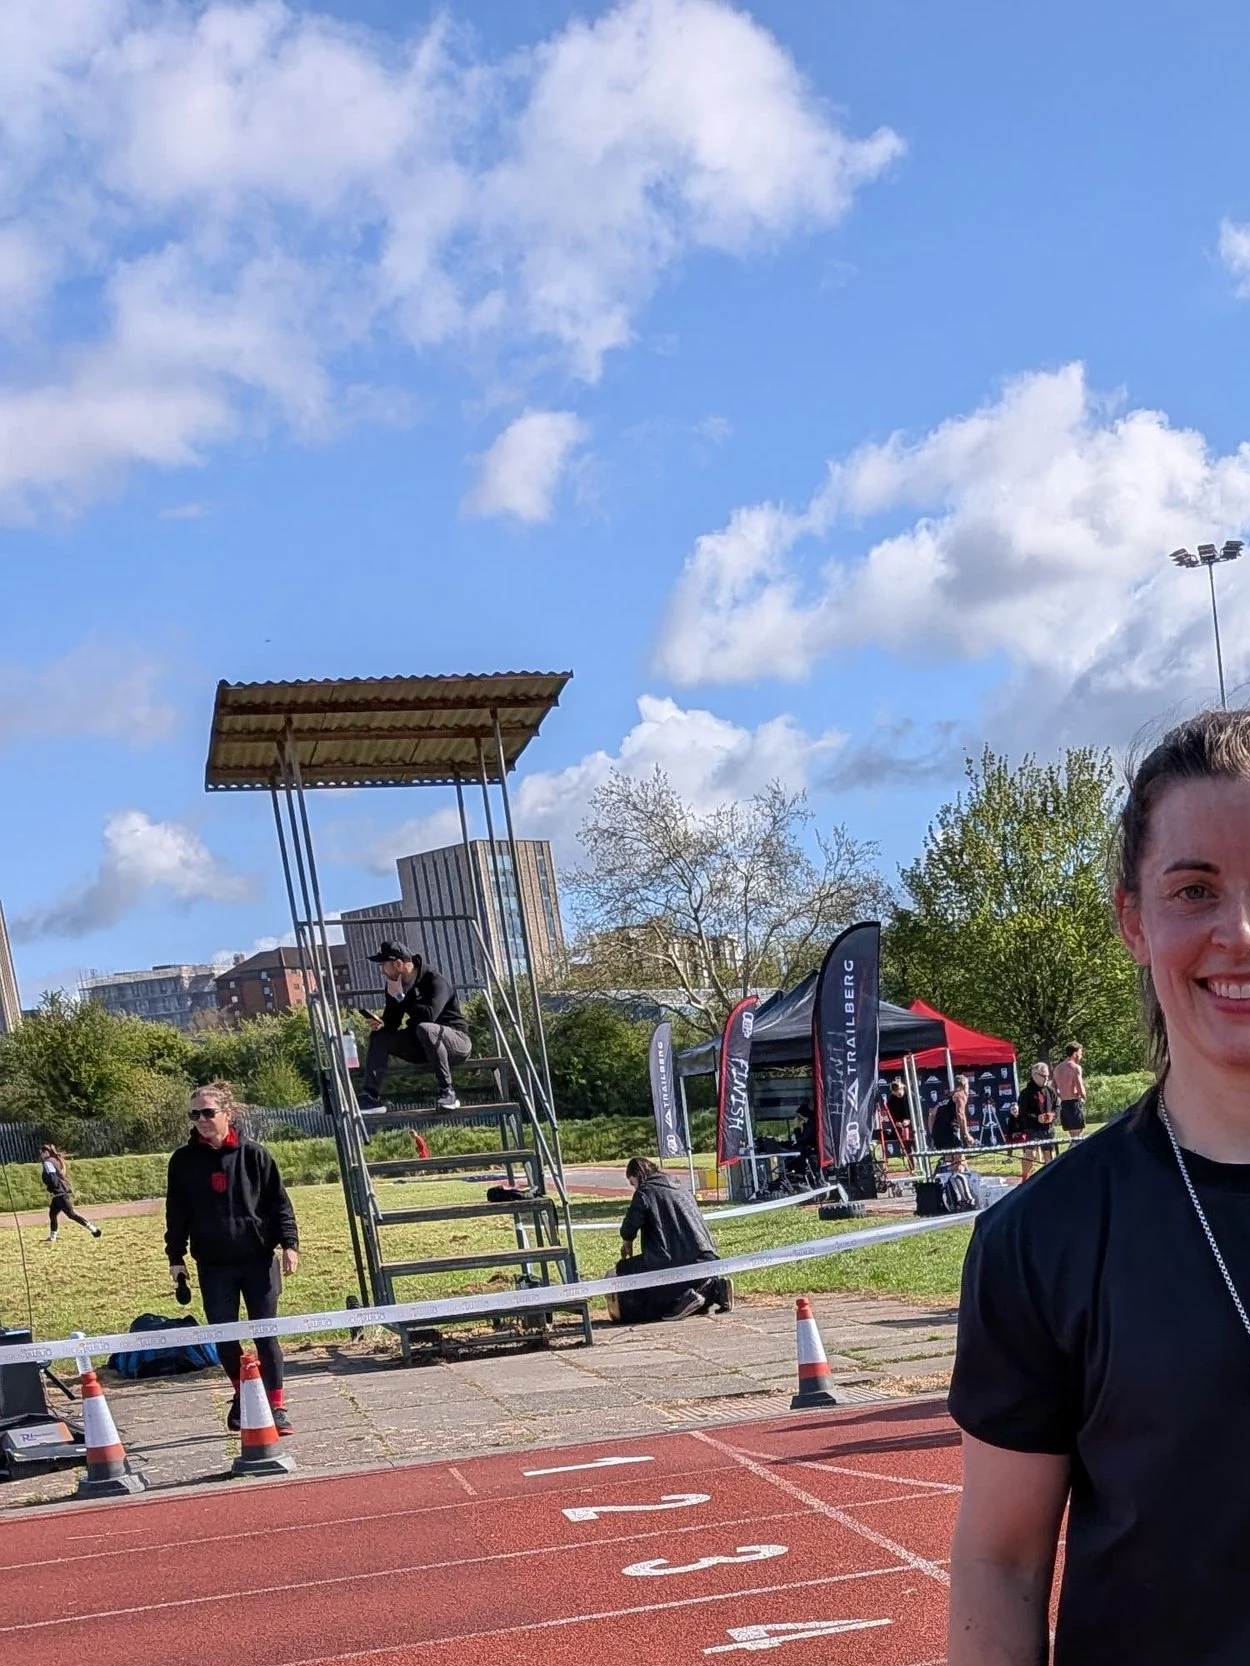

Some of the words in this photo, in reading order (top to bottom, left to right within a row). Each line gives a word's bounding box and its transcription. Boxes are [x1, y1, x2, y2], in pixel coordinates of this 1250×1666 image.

[843, 958, 858, 1076] TRAILBERG
[657, 1041, 670, 1108] TRAILBERG
[728, 1057, 749, 1131] FINISH
[523, 1455, 654, 1477] 1
[562, 1492, 711, 1523] 2
[621, 1544, 789, 1577] 3
[703, 1618, 893, 1656] 4
